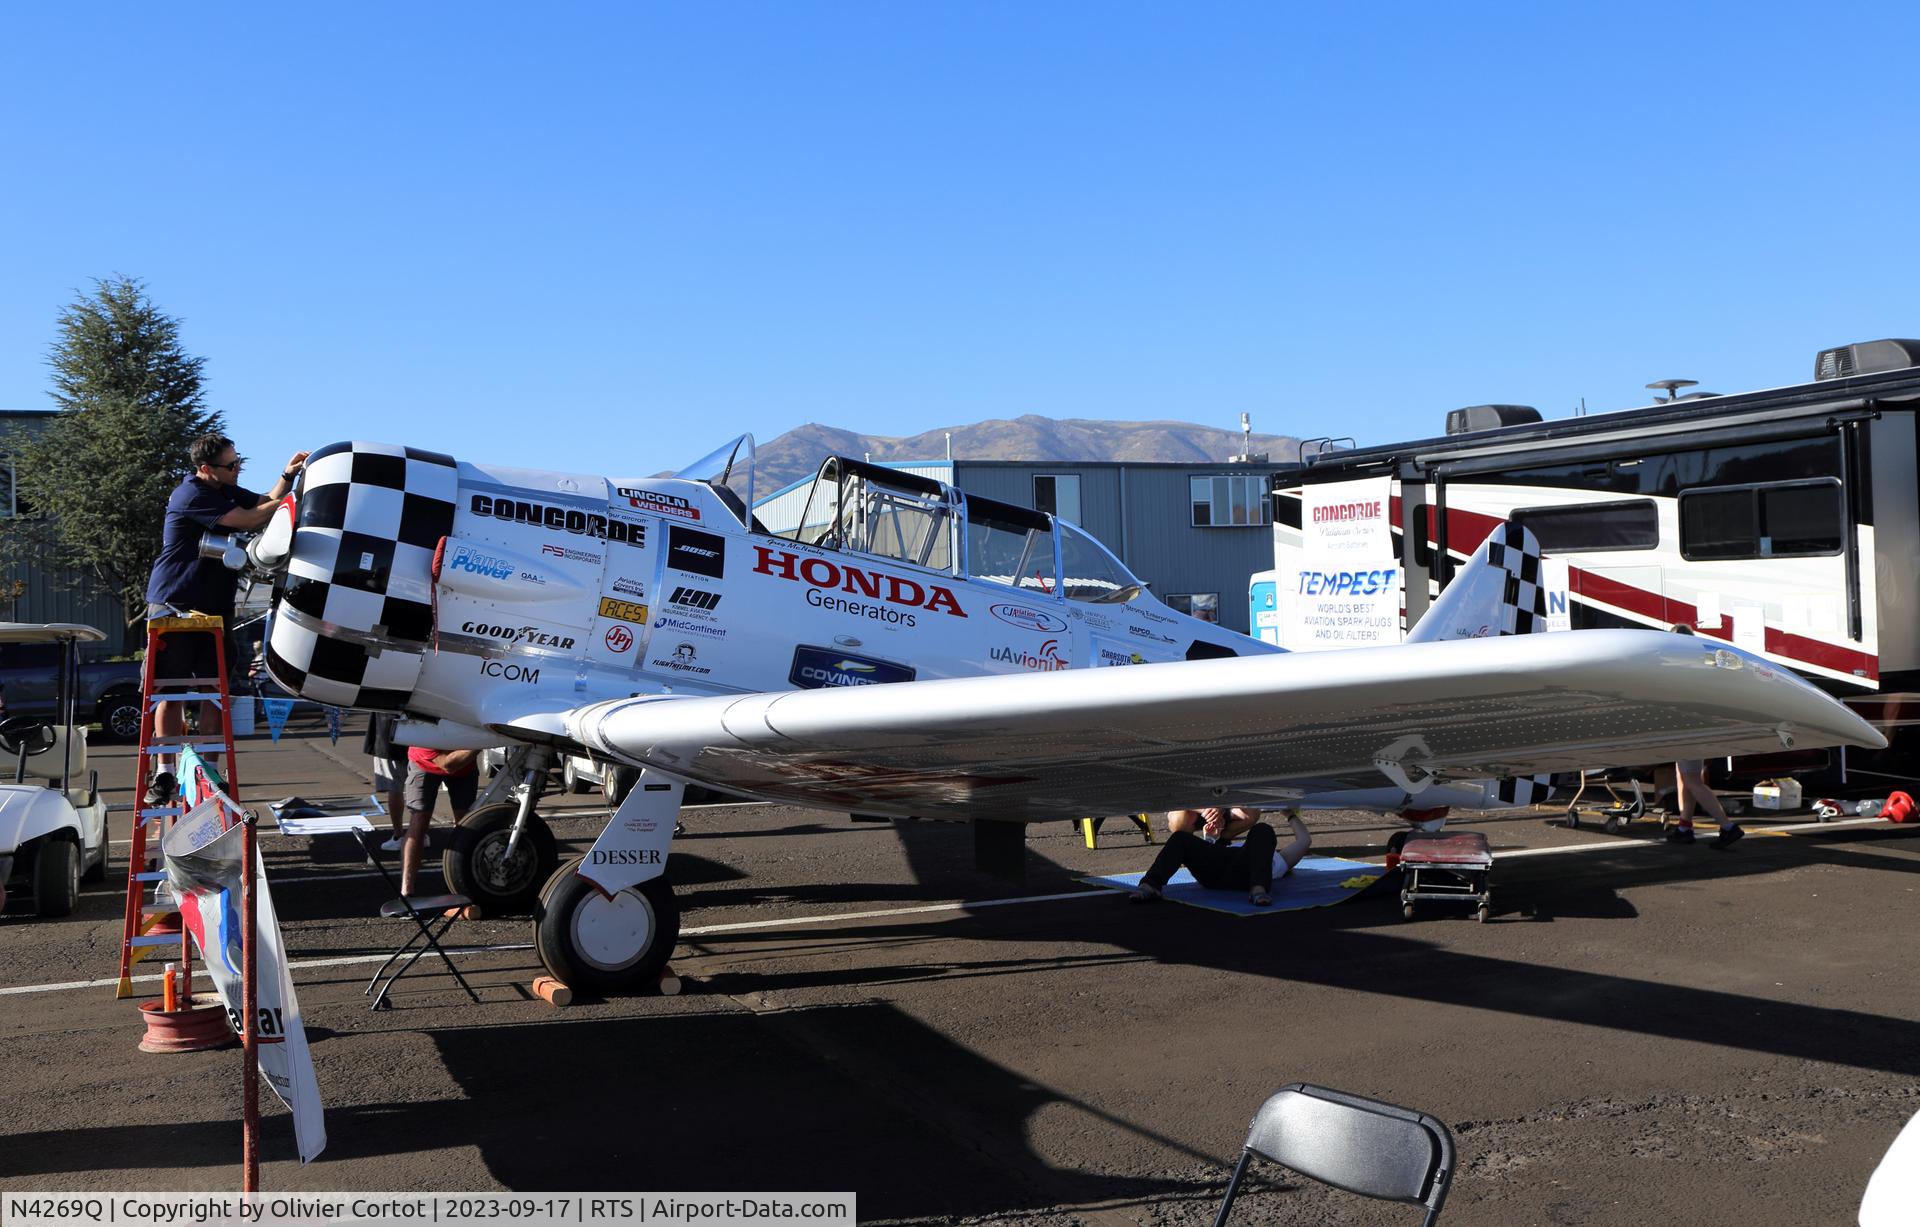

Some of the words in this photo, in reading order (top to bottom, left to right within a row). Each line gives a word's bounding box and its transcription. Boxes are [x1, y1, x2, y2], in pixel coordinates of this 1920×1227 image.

[621, 488, 686, 508] LINCOLN
[636, 500, 693, 518] WELDERS
[1312, 501, 1382, 524] CONCORDE
[471, 494, 646, 549] CONCORDE
[542, 543, 565, 557] PS
[565, 548, 601, 559] ENGINEERING
[564, 553, 601, 565] INCORPORATED
[674, 544, 720, 558] BOSE
[450, 556, 514, 581] Power
[680, 572, 709, 583] AVIATION
[752, 545, 969, 618] HONDA
[1299, 569, 1396, 596] TEMPEST
[605, 601, 642, 622] ACES
[806, 588, 917, 627] Generators
[1317, 603, 1352, 614] WORLD'S
[1353, 603, 1375, 614] BEST
[667, 619, 727, 637] MidContinent
[1304, 616, 1336, 626] AVIATION
[1337, 616, 1364, 626] SPARK
[1364, 617, 1393, 627] PLUGS
[1315, 629, 1331, 639] AND
[1332, 629, 1345, 640] OIL
[1346, 630, 1380, 641] FILTERS!
[1101, 649, 1131, 664] SARASOTA
[480, 660, 540, 685] ICOM
[592, 849, 662, 865] DESSER
